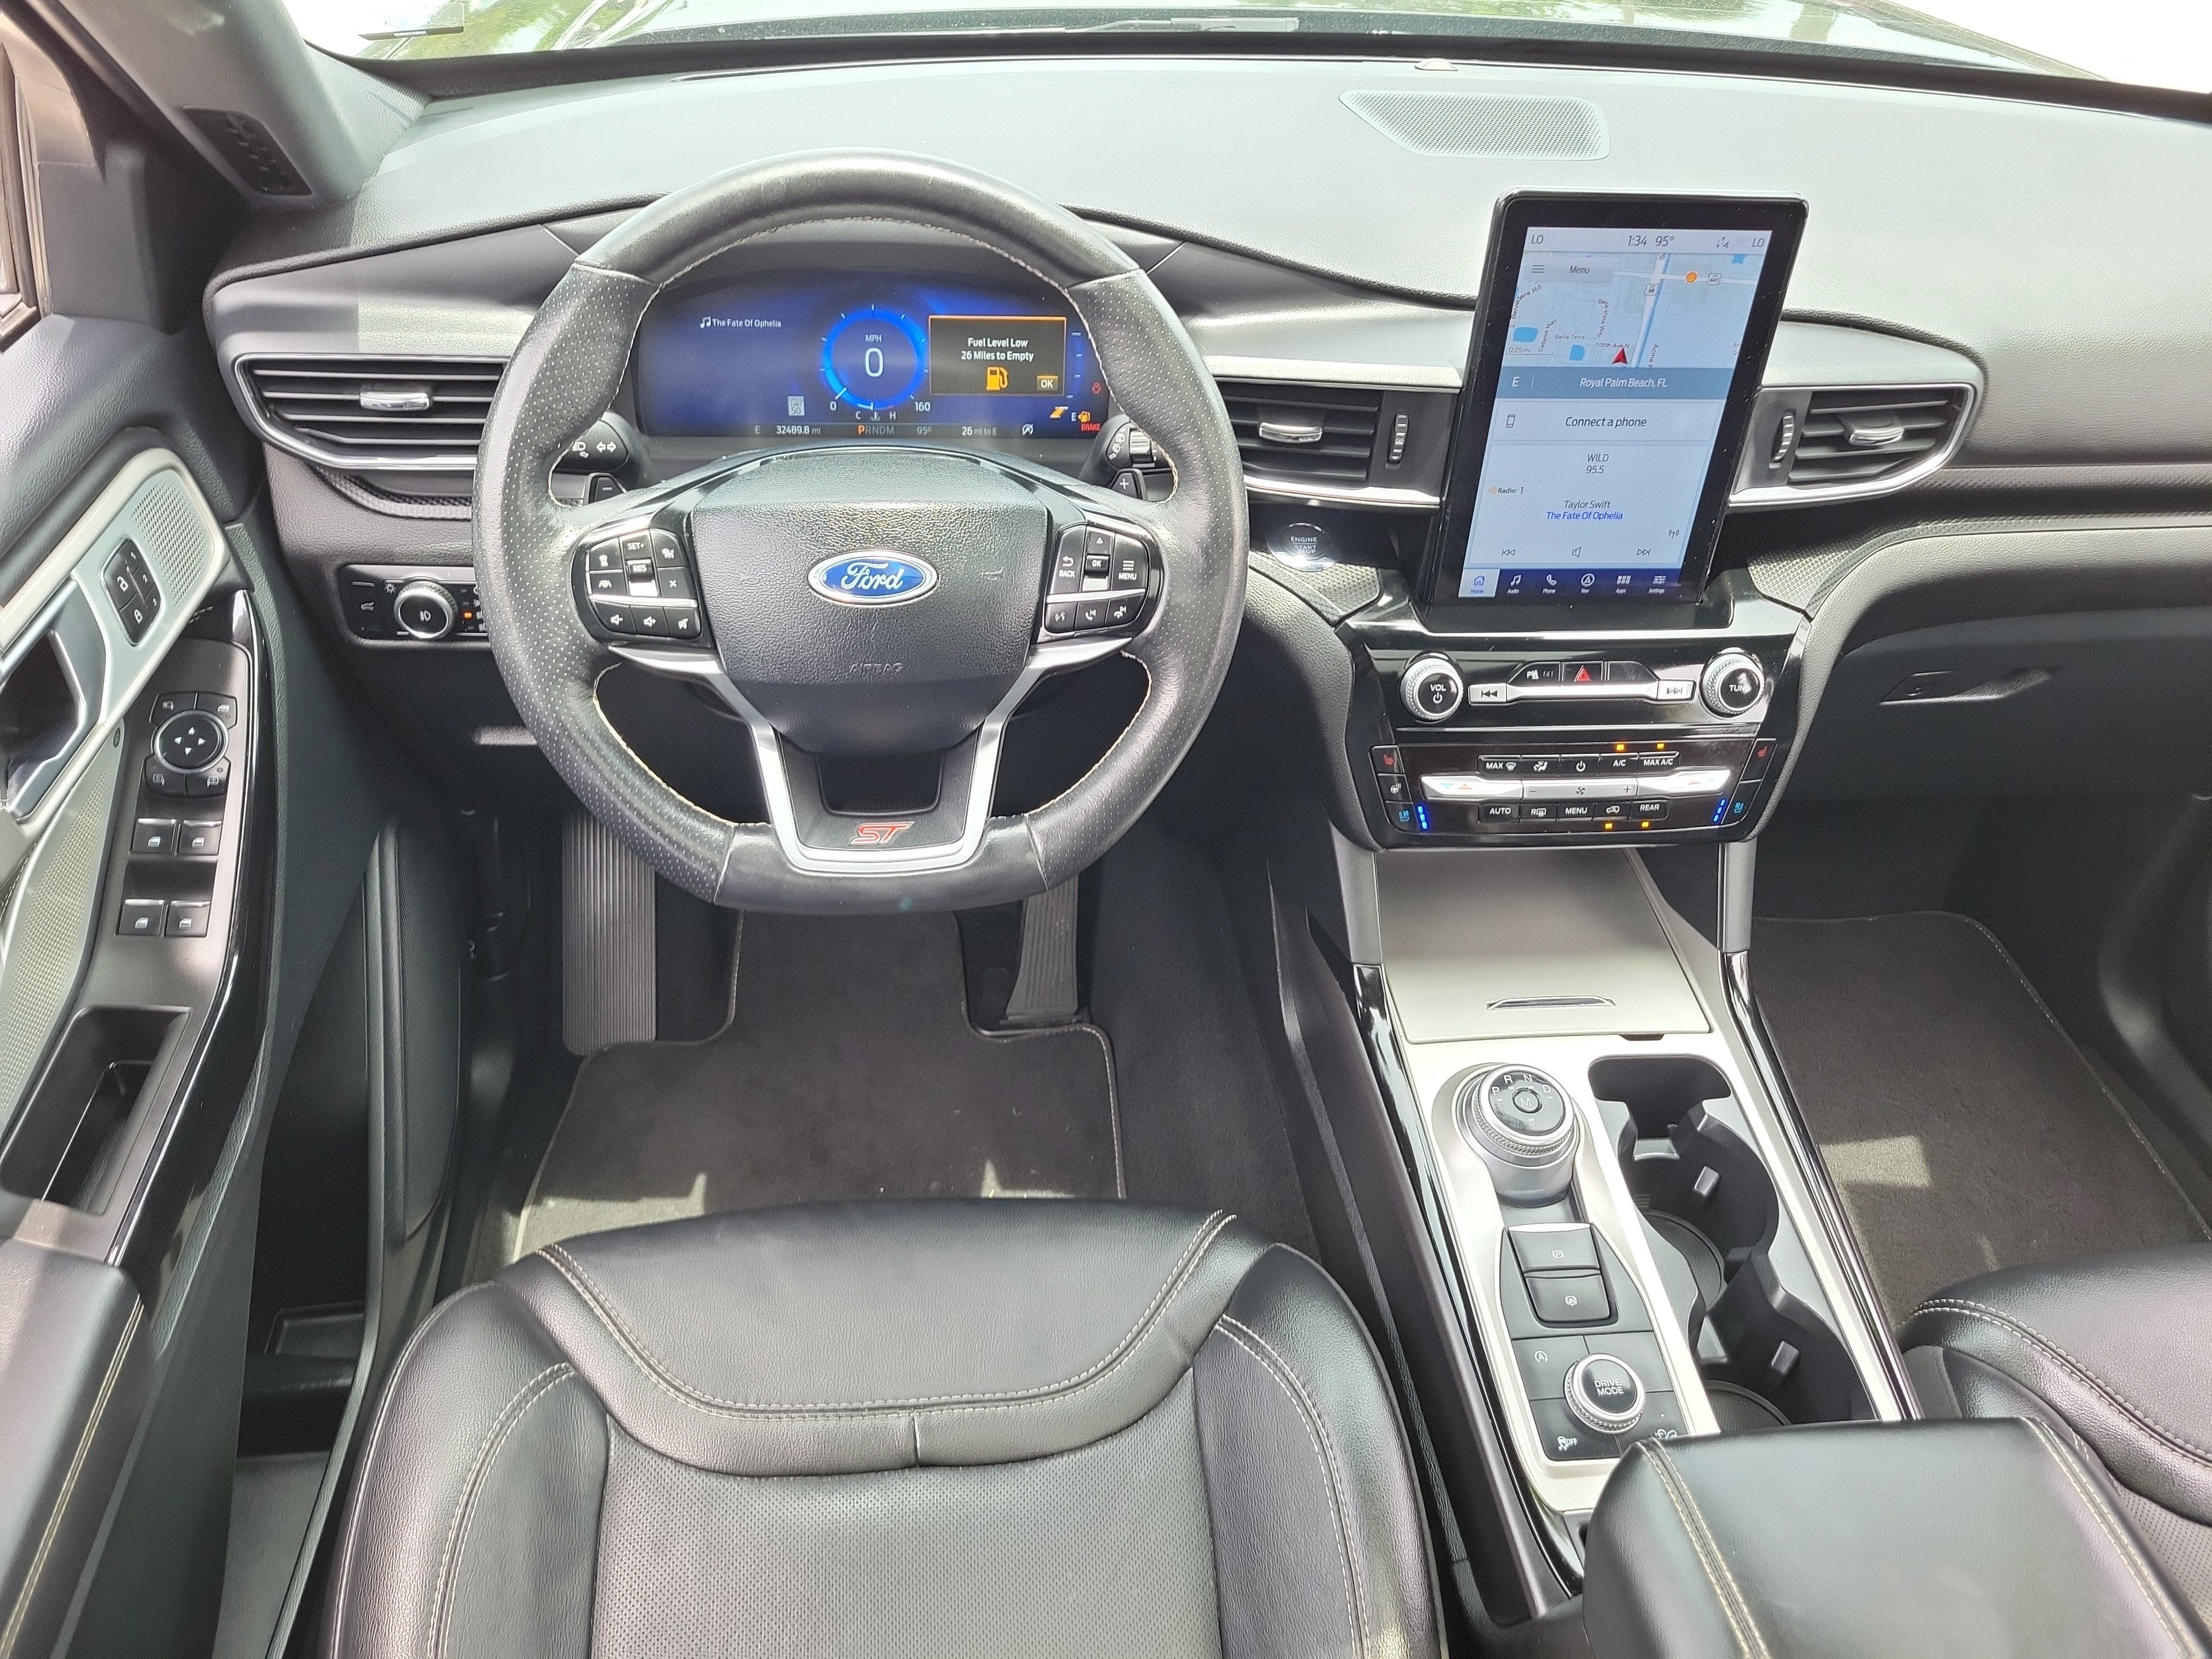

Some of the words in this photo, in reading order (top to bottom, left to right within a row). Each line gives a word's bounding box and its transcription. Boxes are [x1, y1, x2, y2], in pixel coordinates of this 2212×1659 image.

[1531, 234, 1544, 244] LO
[1628, 235, 1647, 247] 1:34
[1752, 238, 1764, 247] LO
[1569, 265, 1590, 274] Menu
[1510, 291, 1531, 319] Belvedere
[1532, 284, 1542, 294] Rd
[1600, 309, 1609, 324] Vista
[712, 318, 726, 328] The
[727, 318, 743, 328] Fate
[744, 319, 753, 328] Of
[754, 319, 782, 329] Ophelia
[1538, 329, 1549, 352] Catania
[1544, 318, 1557, 330] Way
[1596, 326, 1605, 338] Way
[865, 334, 882, 342] MPH
[968, 337, 986, 347] Fuel
[988, 337, 1009, 347] Level
[1011, 338, 1028, 347] Low
[961, 351, 972, 360] 26
[973, 351, 995, 360] Miles
[996, 352, 1005, 361] to
[1007, 352, 1034, 362] Empty
[1649, 343, 1658, 363] Acme
[865, 347, 883, 377] 0
[1041, 380, 1053, 388] OK
[1512, 376, 1520, 387] E
[1579, 377, 1603, 388] Royal
[1604, 377, 1627, 387] Palm
[1628, 378, 1656, 388] Beach,
[1657, 378, 1668, 387] FL
[791, 407, 802, 415] 50
[830, 403, 837, 411] 0
[915, 402, 930, 411] 160
[855, 411, 862, 420] C
[890, 411, 896, 420] H
[1071, 412, 1076, 422] E
[1565, 417, 1606, 427] Connect
[1607, 419, 1613, 427] a
[1615, 417, 1647, 428] phone
[755, 425, 761, 434] E
[776, 425, 810, 435] 32489.8
[812, 426, 821, 435] mi
[962, 426, 973, 436] 26
[974, 427, 983, 435] mi
[1587, 454, 1609, 462] WILD
[1586, 465, 1605, 473] 95.5
[1564, 500, 1589, 510] Taylor
[1589, 500, 1611, 509] Swift
[1547, 511, 1561, 520] The
[1562, 511, 1581, 520] Fate
[1582, 511, 1592, 520] Of
[1593, 511, 1623, 521] Ophelia
[131, 551, 137, 560] 1
[633, 565, 647, 573] RES
[1058, 569, 1075, 578] BACK
[143, 574, 148, 584] 2
[840, 562, 905, 591] Ford
[1118, 572, 1137, 580] MENU
[1430, 684, 1447, 692] VOL
[1640, 804, 1660, 812] REAR
[849, 821, 915, 846] ST
[1503, 1075, 1514, 1084] R
[1523, 1074, 1533, 1083] N
[1492, 1086, 1500, 1096] P
[1542, 1084, 1551, 1093] D
[1520, 1098, 1532, 1107] M
[1594, 1378, 1622, 1388] DRIVE
[1596, 1387, 1624, 1397] MODE
[1566, 1437, 1578, 1446] OFF
